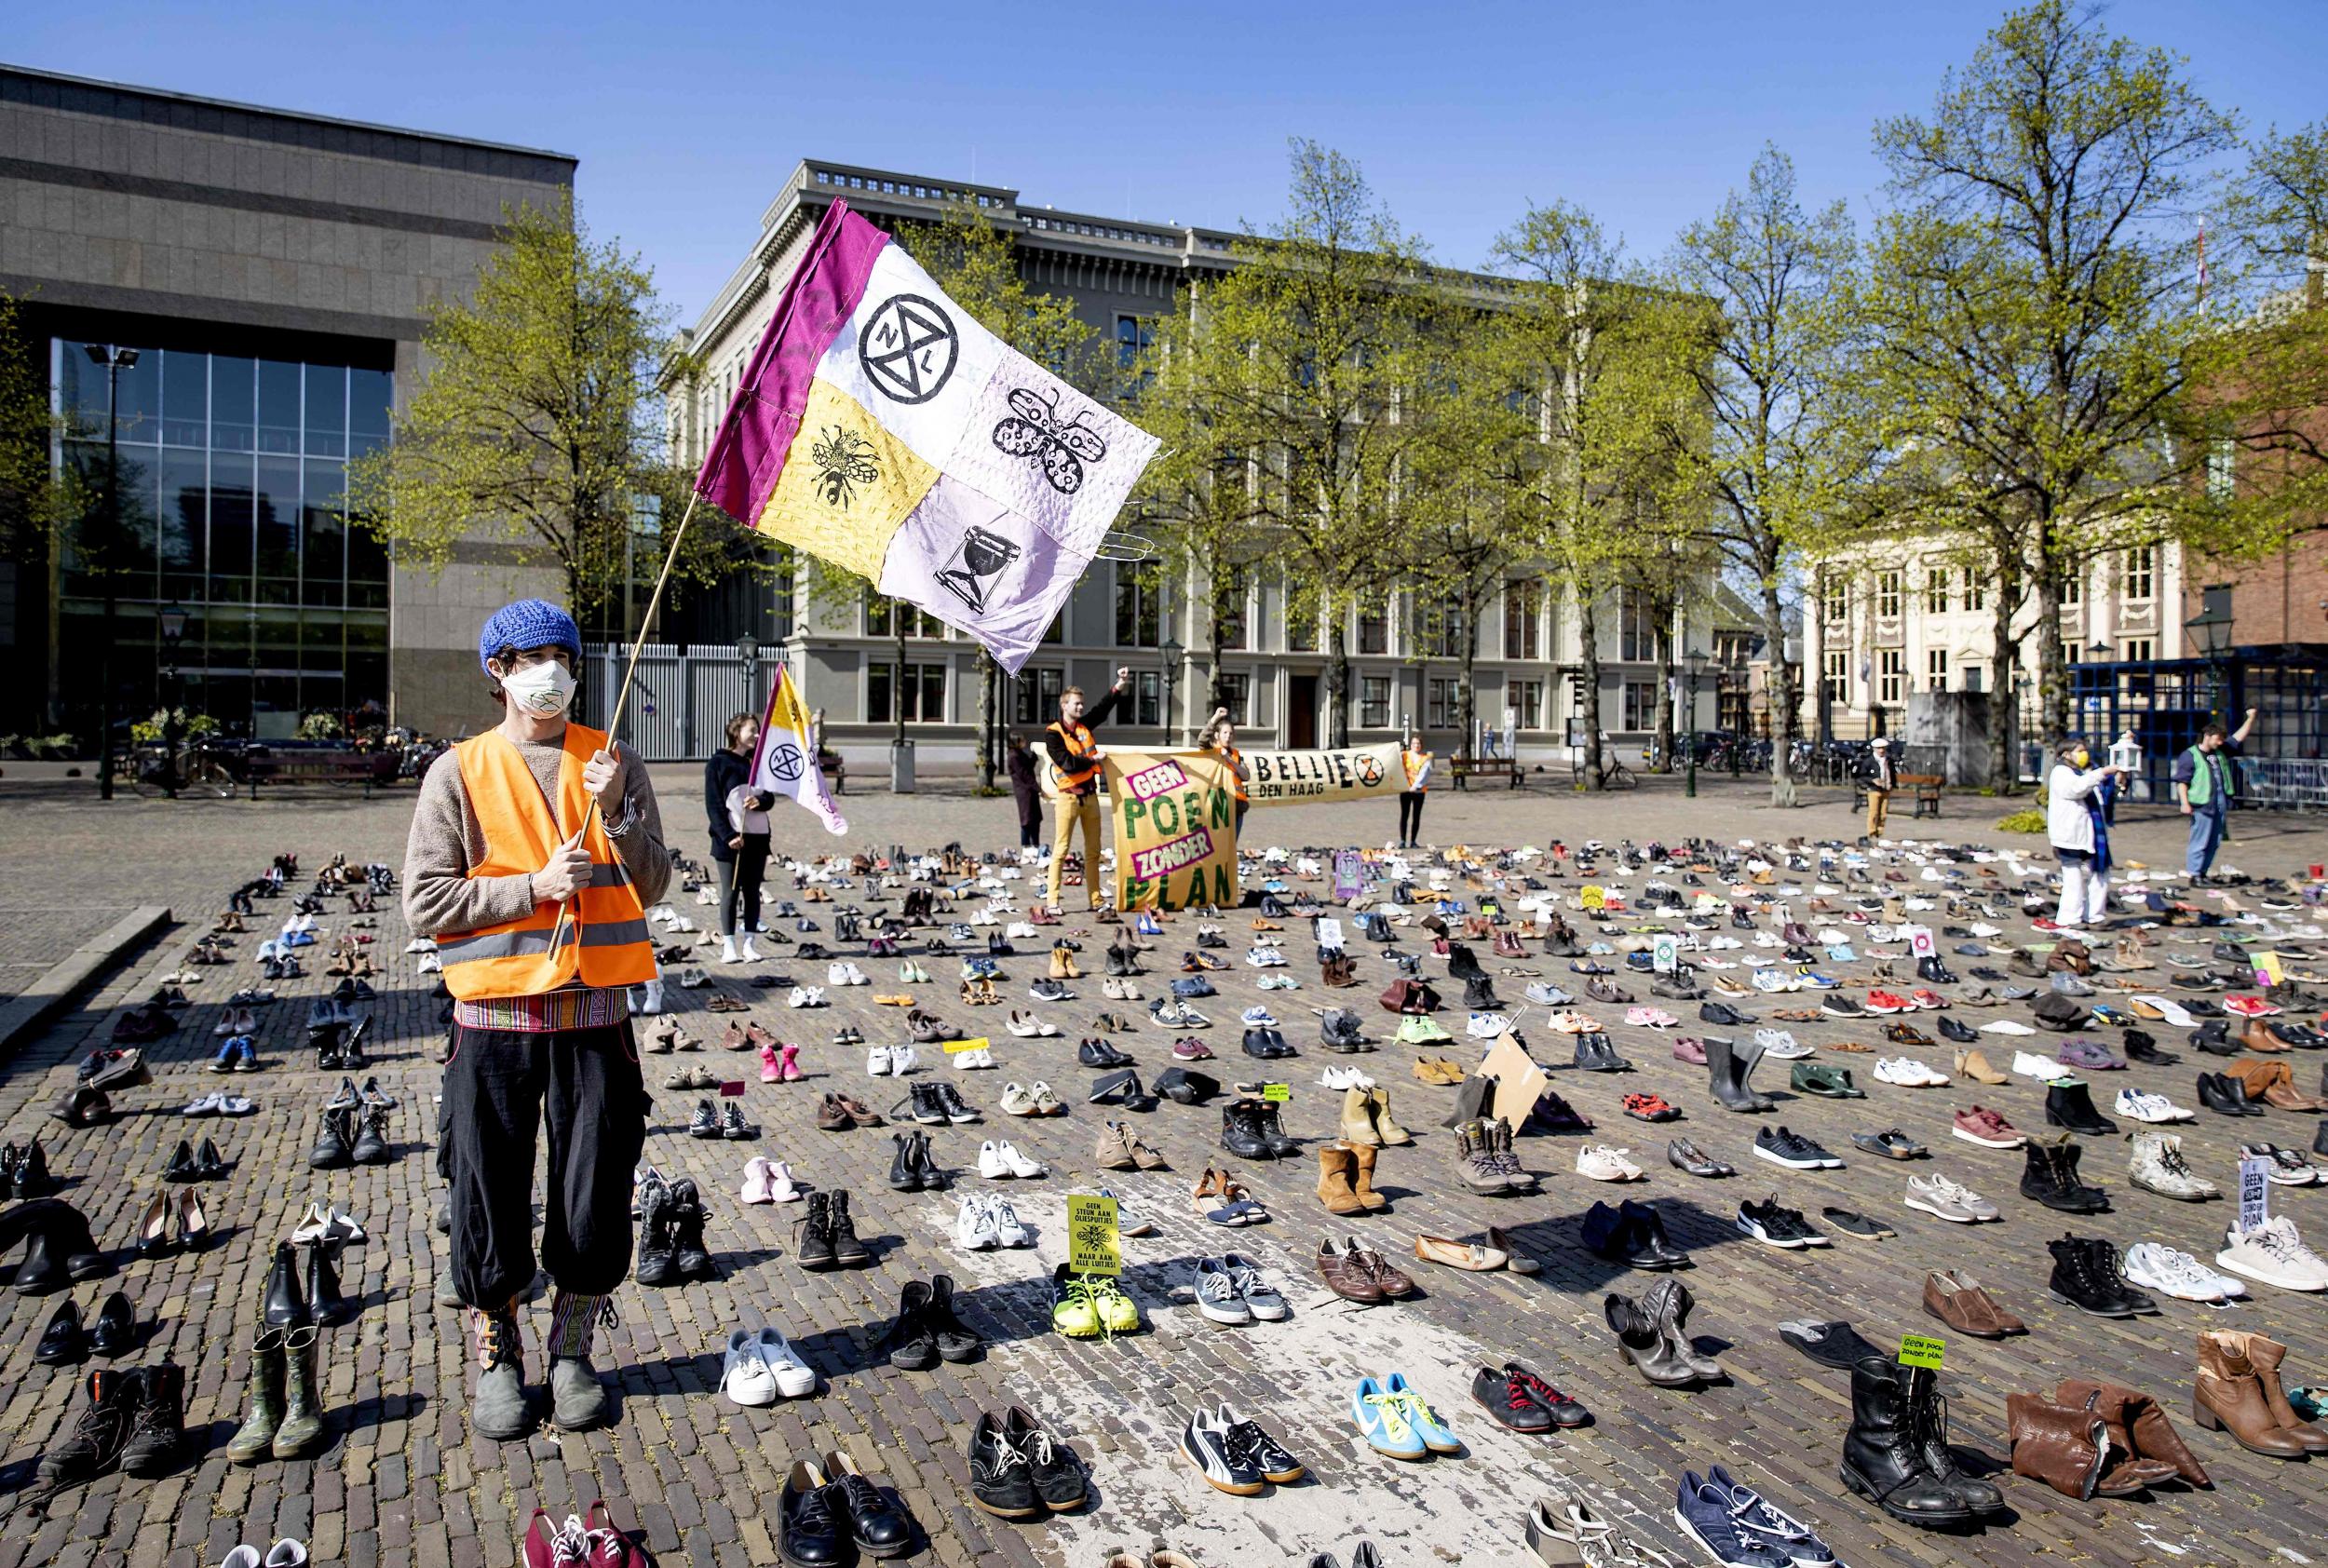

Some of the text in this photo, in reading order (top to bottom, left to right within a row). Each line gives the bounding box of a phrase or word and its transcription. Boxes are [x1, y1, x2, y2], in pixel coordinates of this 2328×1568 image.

[1132, 763, 1184, 798] GEEN
[1240, 754, 1353, 788] BELLIE
[1259, 784, 1282, 798] DEN
[1289, 782, 1324, 797] HAAG
[1124, 787, 1230, 838] POEN
[1136, 832, 1211, 878] ZONDER
[1126, 861, 1231, 911] PLAN
[2245, 1173, 2264, 1186] GEEN
[1075, 1215, 1113, 1224] OLIESPUITJES
[2244, 1203, 2263, 1212] ZONDER
[2244, 1212, 2263, 1226] PLAN
